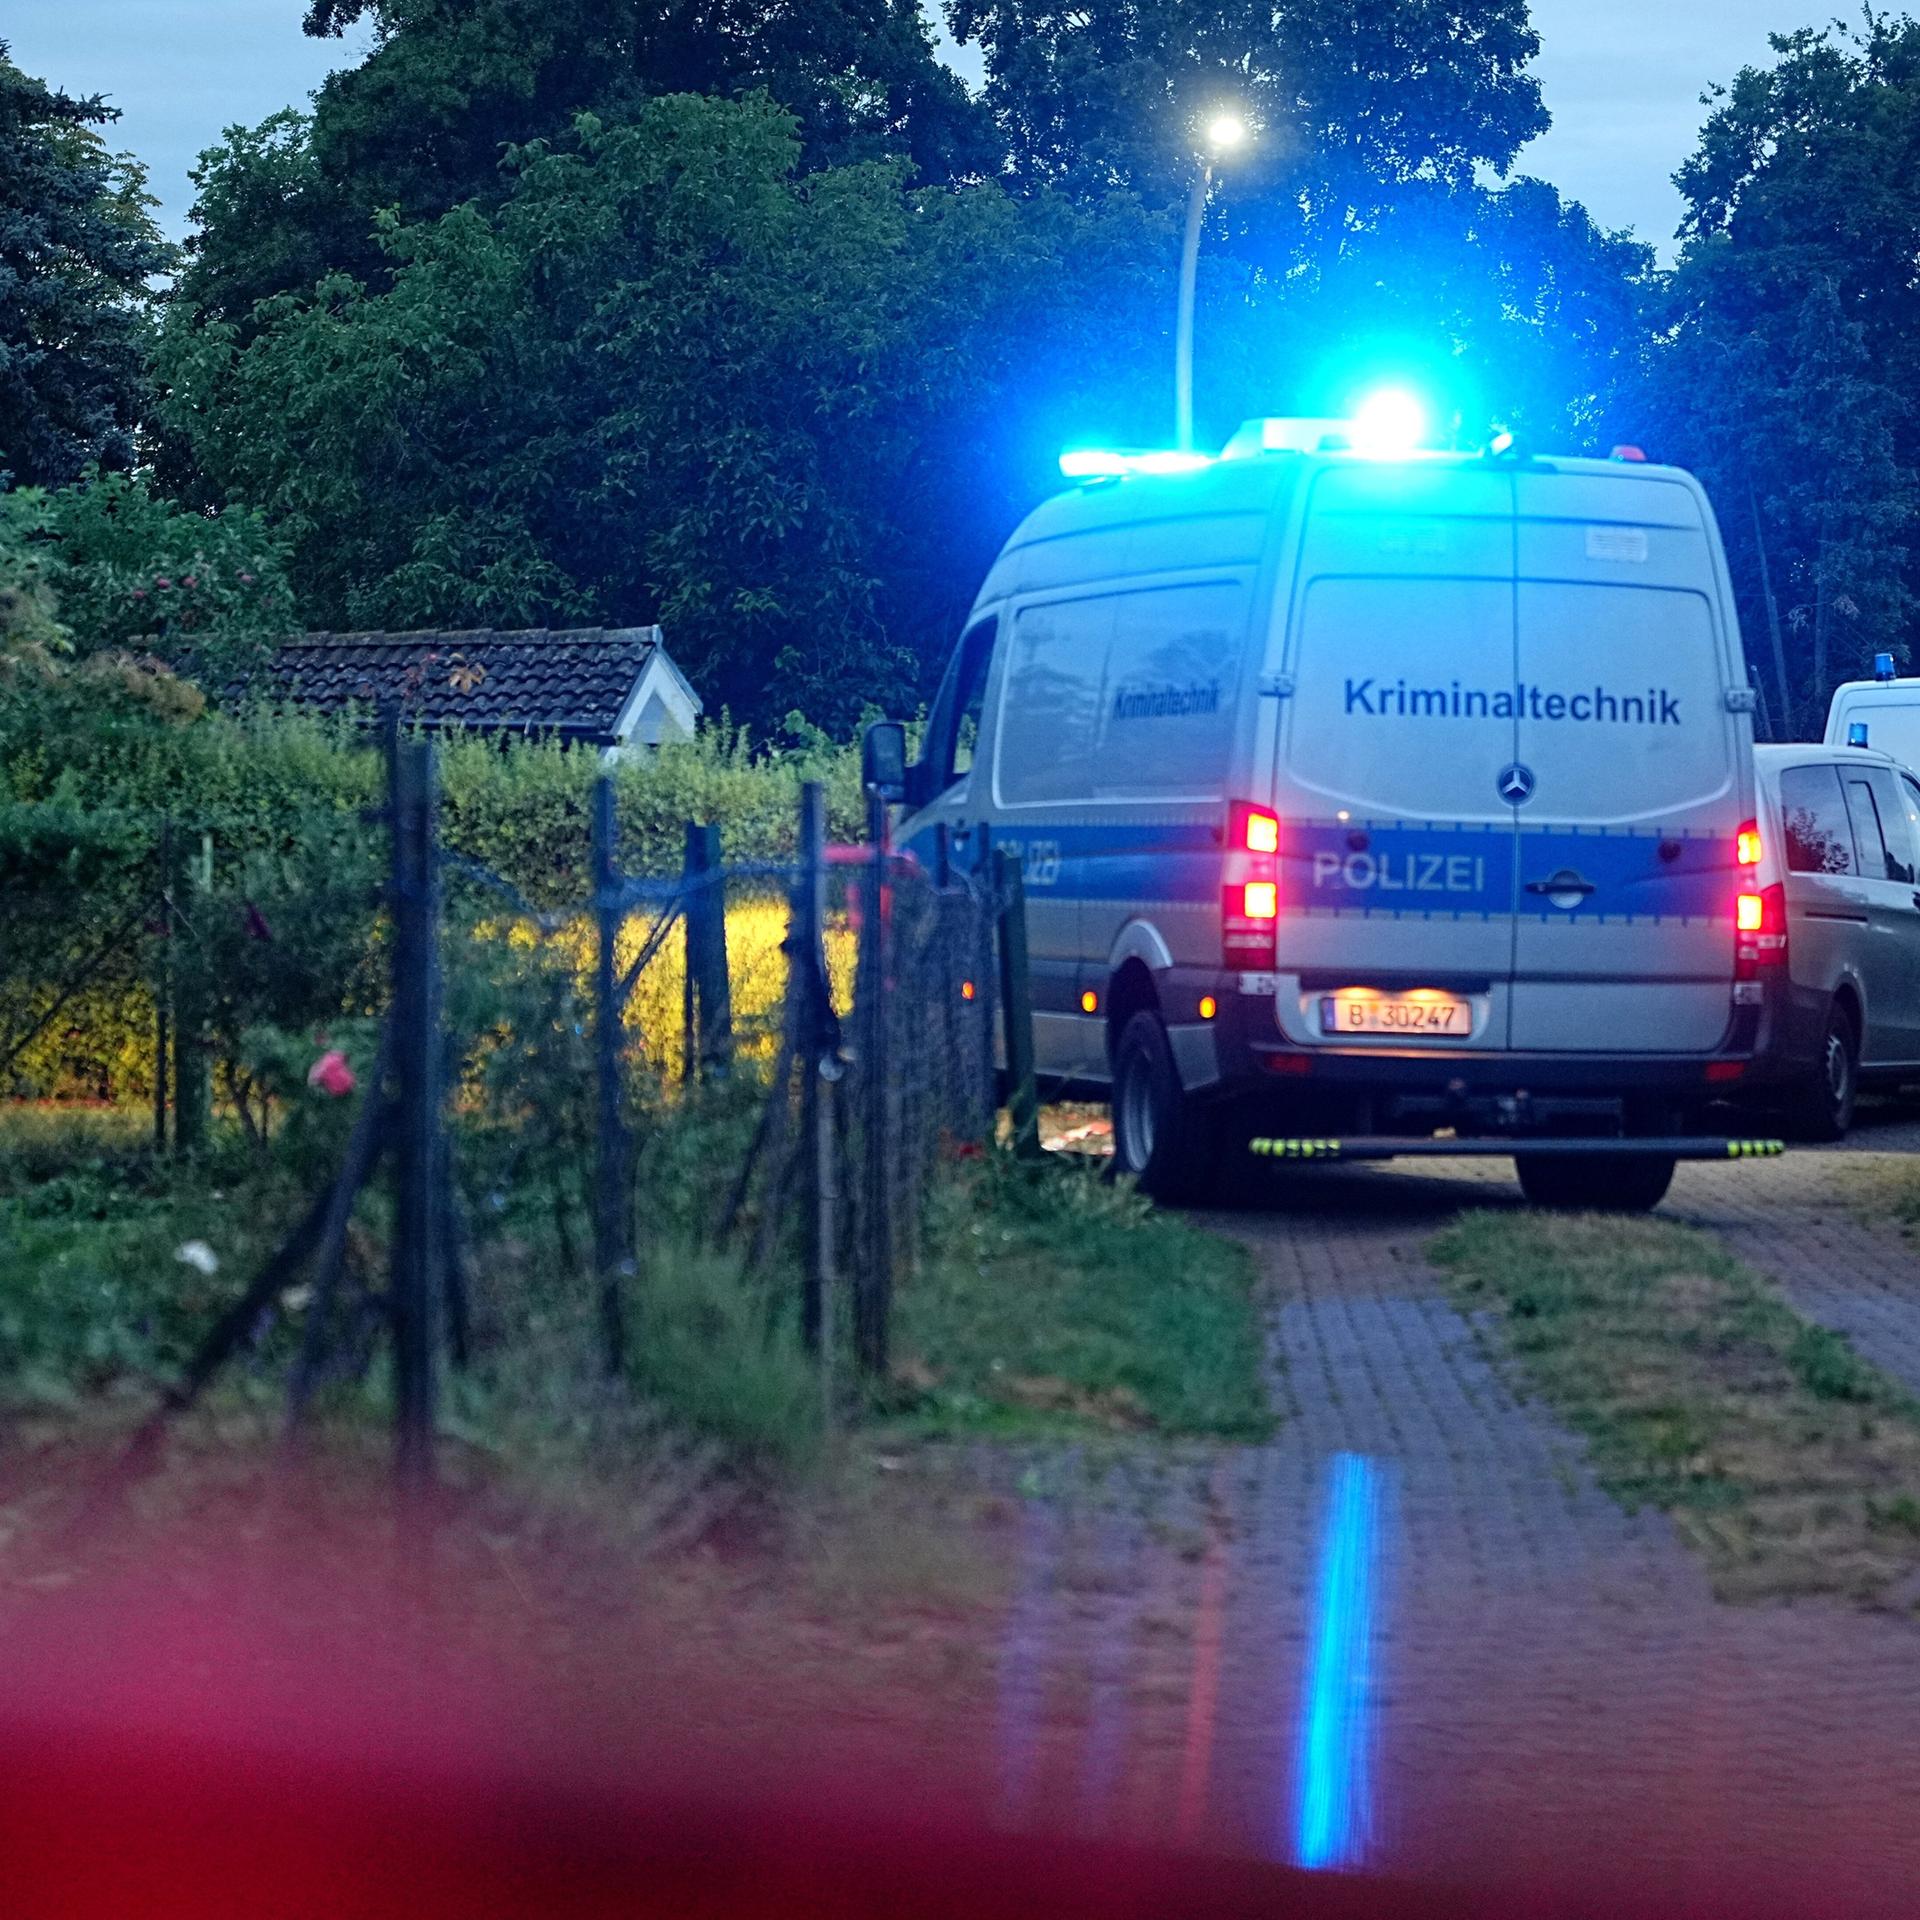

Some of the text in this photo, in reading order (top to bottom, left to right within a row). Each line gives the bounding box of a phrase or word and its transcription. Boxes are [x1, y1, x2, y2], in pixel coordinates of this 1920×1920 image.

[1344, 679, 1681, 725] Kriminaltechnik
[1313, 853, 1484, 892] POLIZEI
[1350, 1004, 1456, 1028] B 30247
